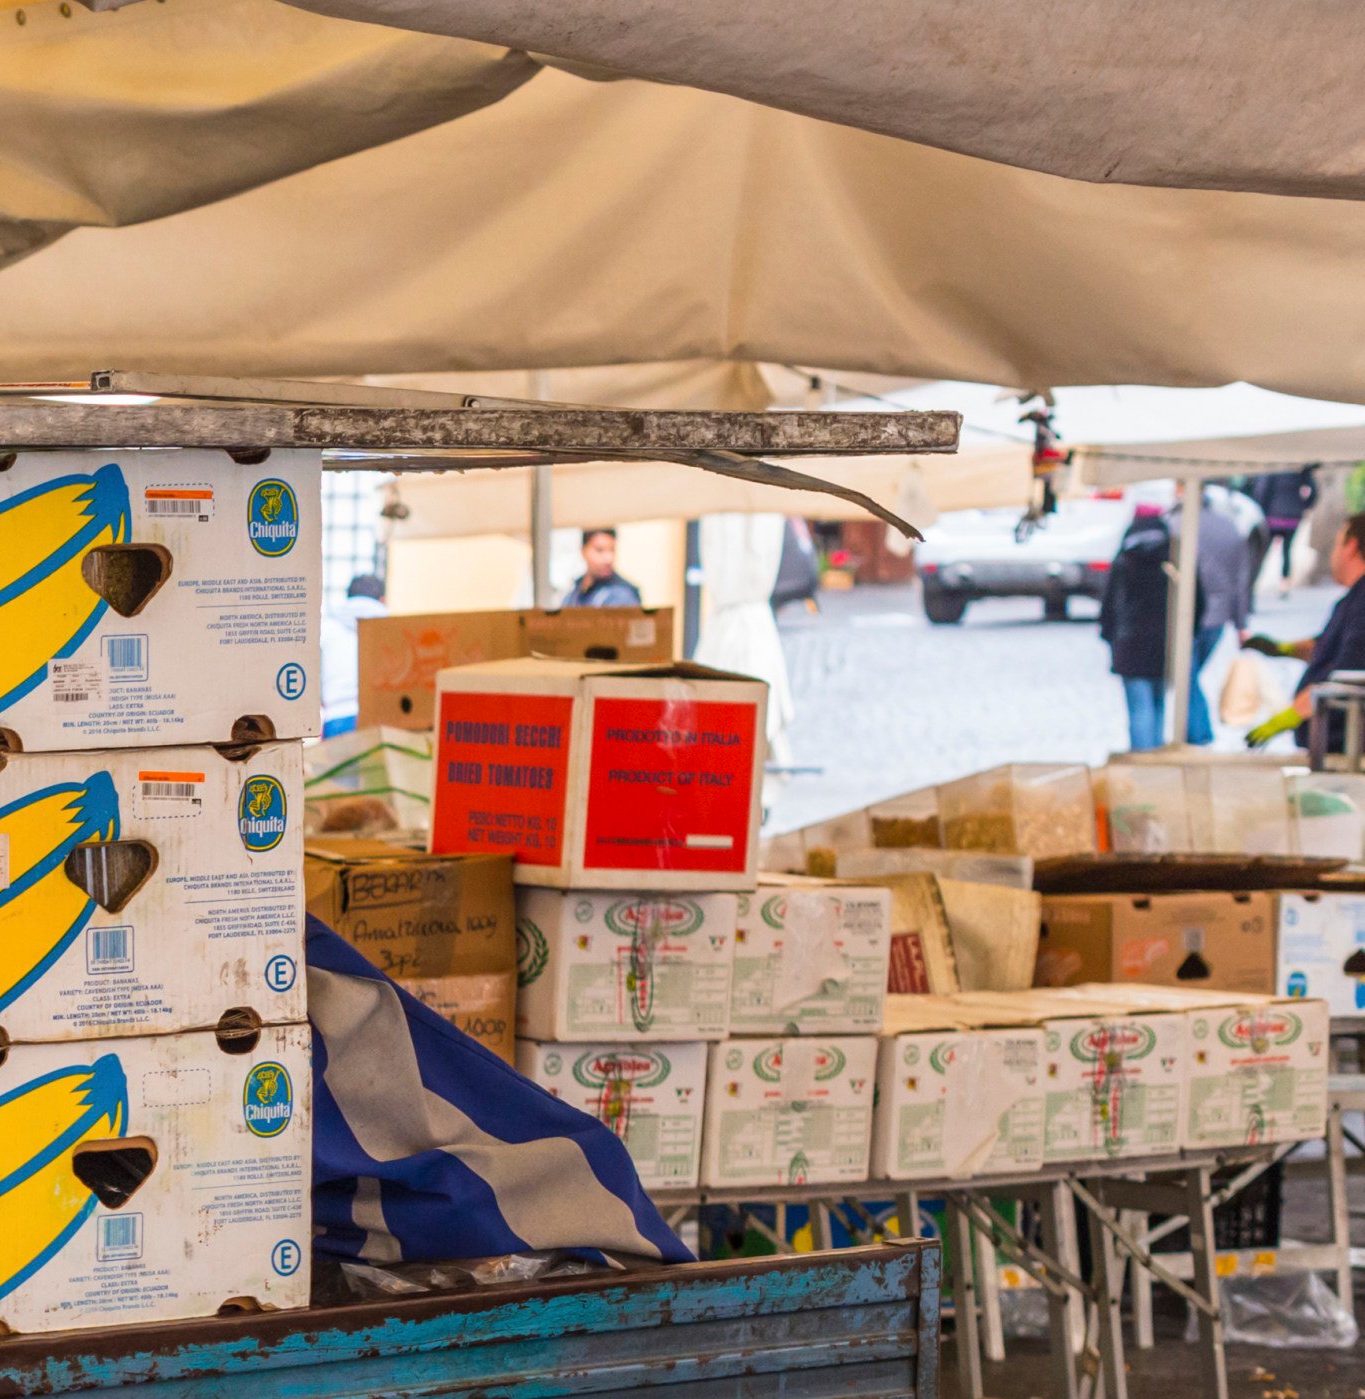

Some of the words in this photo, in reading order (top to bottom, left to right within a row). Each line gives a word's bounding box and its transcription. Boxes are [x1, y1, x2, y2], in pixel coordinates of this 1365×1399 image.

[249, 521, 297, 543] Chiquita
[446, 720, 510, 746] POMODORI
[515, 724, 562, 749] SECCHI
[606, 727, 681, 745] PRODOTTO
[684, 732, 698, 745] IN
[701, 732, 741, 746] ITALIA
[448, 761, 482, 785] DRIED
[488, 763, 554, 790] TOMATOES
[608, 769, 674, 784] PRODUCT
[677, 772, 695, 785] OF
[699, 772, 734, 787] ITALY
[469, 811, 492, 826] PESO
[495, 813, 524, 829] NETTO
[468, 828, 485, 843] NET
[488, 830, 523, 846] WEIGHT
[245, 1100, 291, 1125] Chiquita
